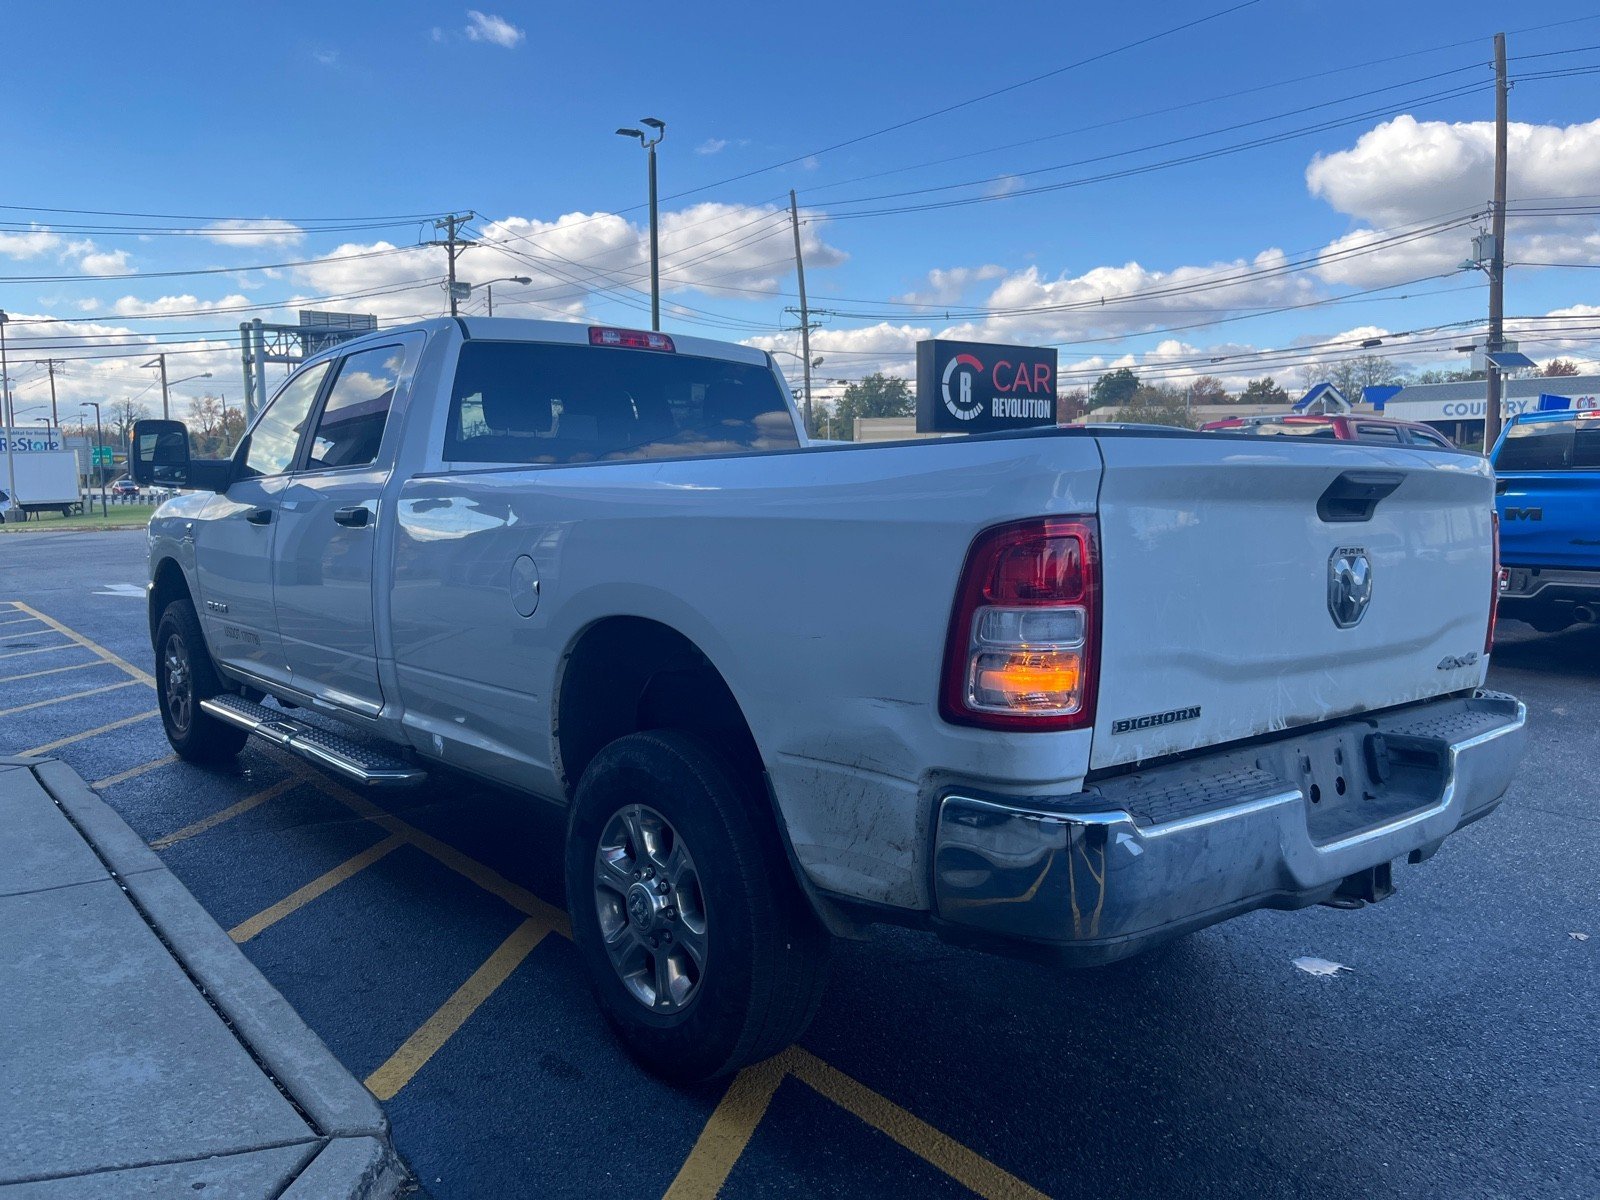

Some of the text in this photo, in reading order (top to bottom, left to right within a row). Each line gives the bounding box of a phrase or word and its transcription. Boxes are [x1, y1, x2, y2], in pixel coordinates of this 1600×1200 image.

[992, 360, 1051, 393] CAR
[992, 398, 1051, 419] REVOLUTION
[1443, 400, 1527, 416] COURY
[1115, 706, 1201, 733] BIGHORN
